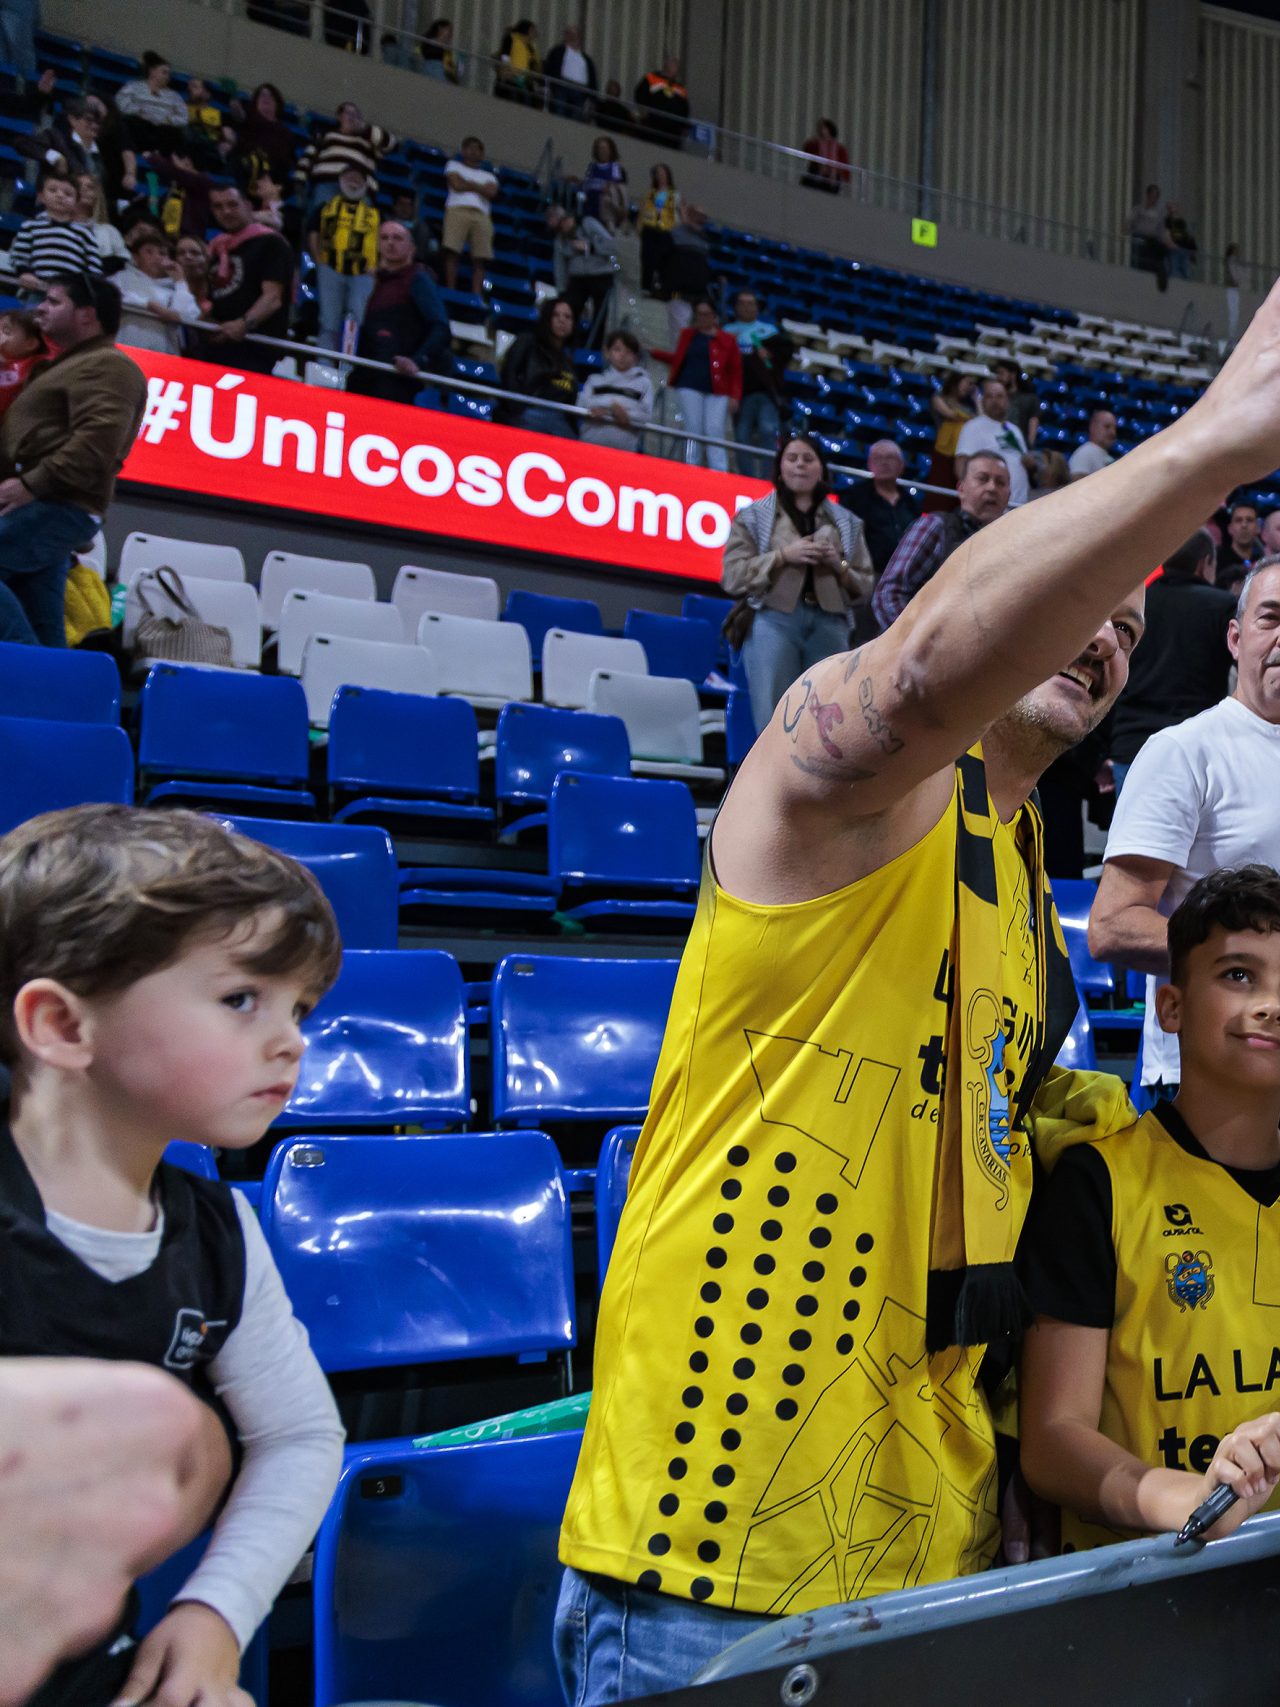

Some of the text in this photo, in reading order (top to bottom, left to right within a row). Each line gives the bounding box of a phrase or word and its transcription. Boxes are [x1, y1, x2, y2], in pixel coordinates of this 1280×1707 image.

[138, 374, 752, 549] #ÚnicosComo
[979, 1127, 1007, 1182] CANARIAS
[1154, 1353, 1221, 1401] LA
[376, 1481, 385, 1494] 3
